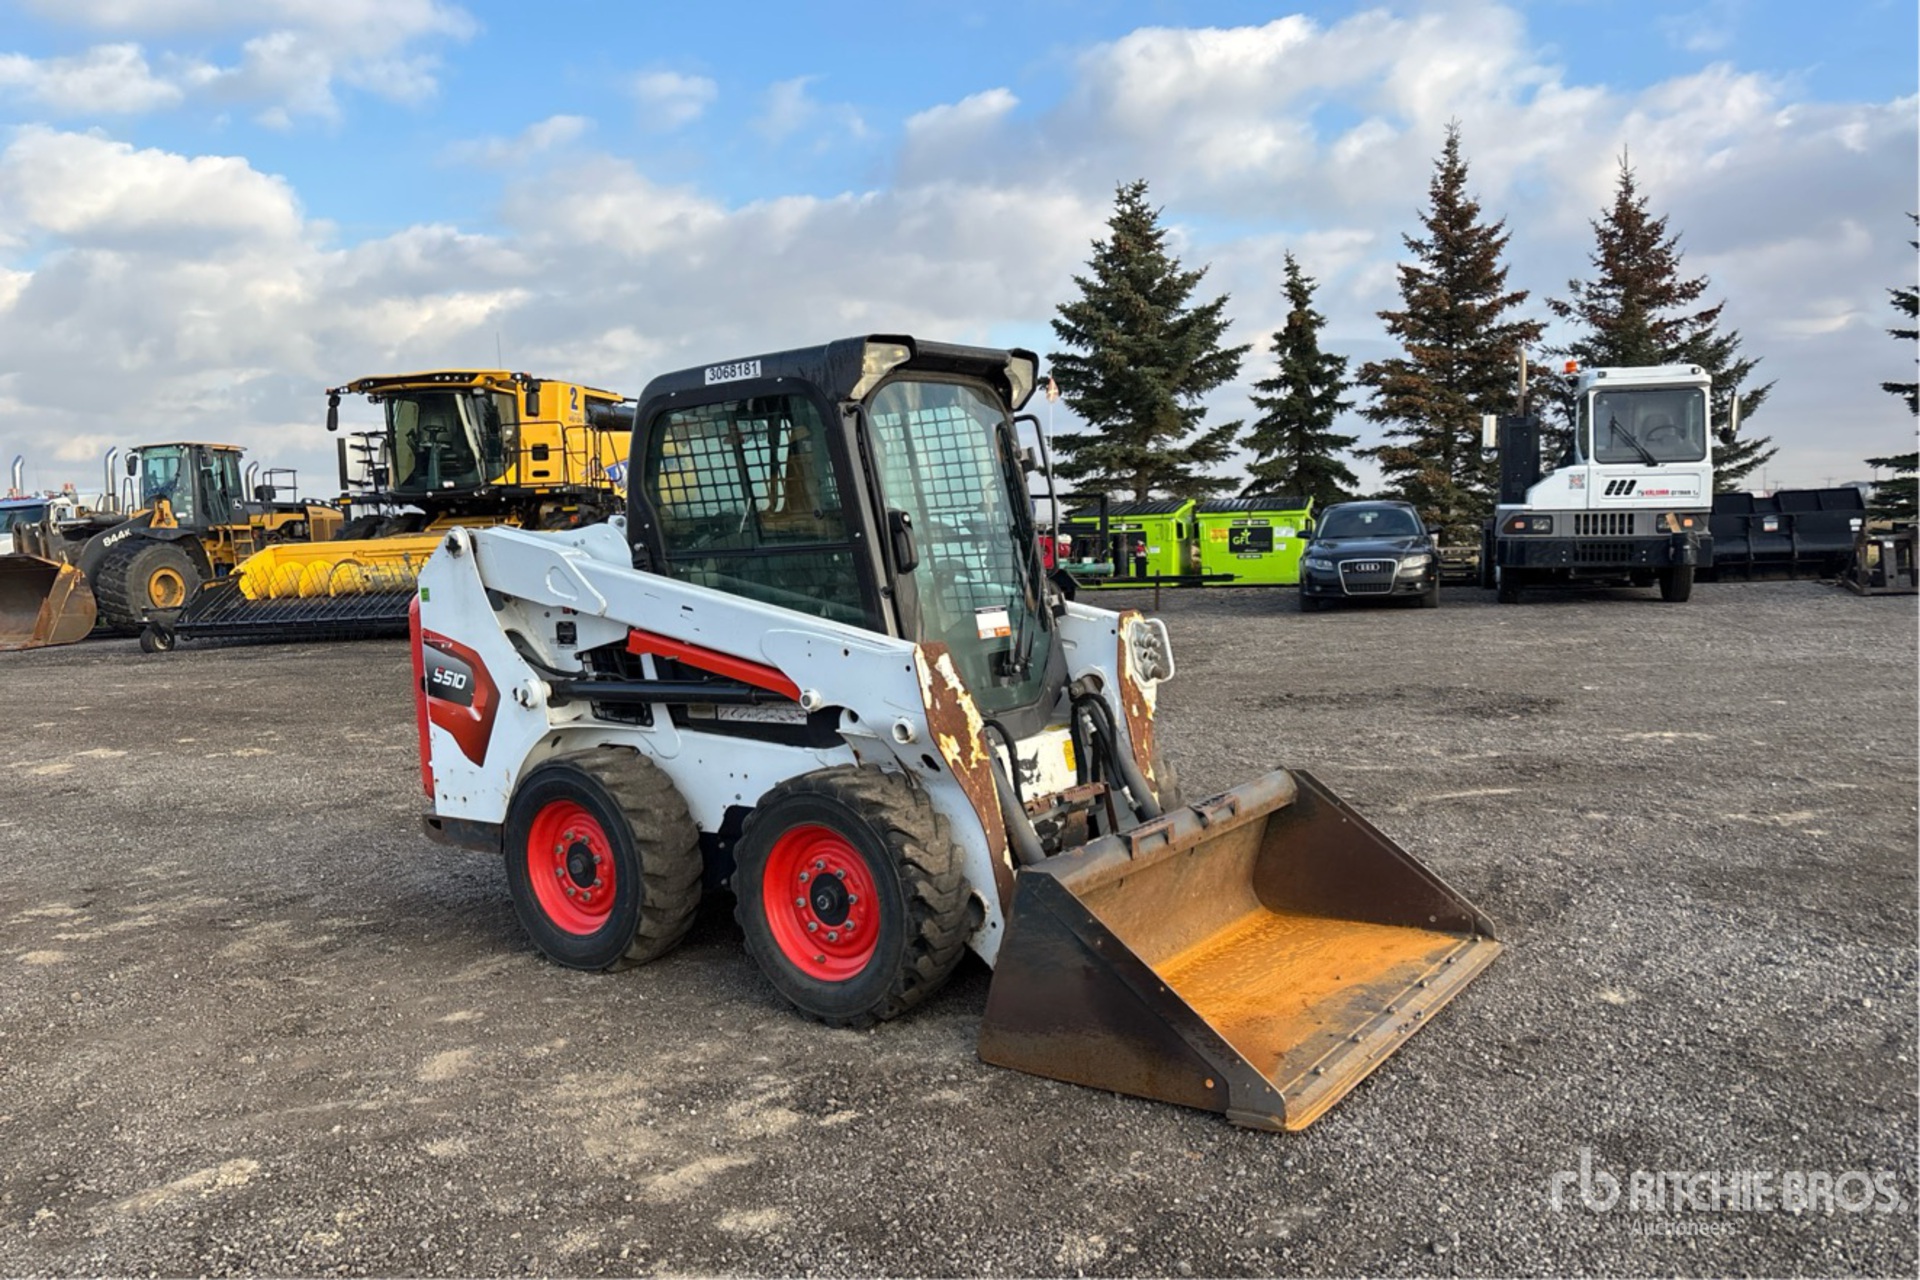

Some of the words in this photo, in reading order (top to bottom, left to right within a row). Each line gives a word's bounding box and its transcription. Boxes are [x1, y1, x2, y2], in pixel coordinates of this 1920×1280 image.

[709, 361, 758, 381] 3068181
[570, 386, 578, 410] 2
[103, 528, 132, 546] 844K
[1232, 534, 1251, 545] GFL
[432, 666, 467, 690] S510
